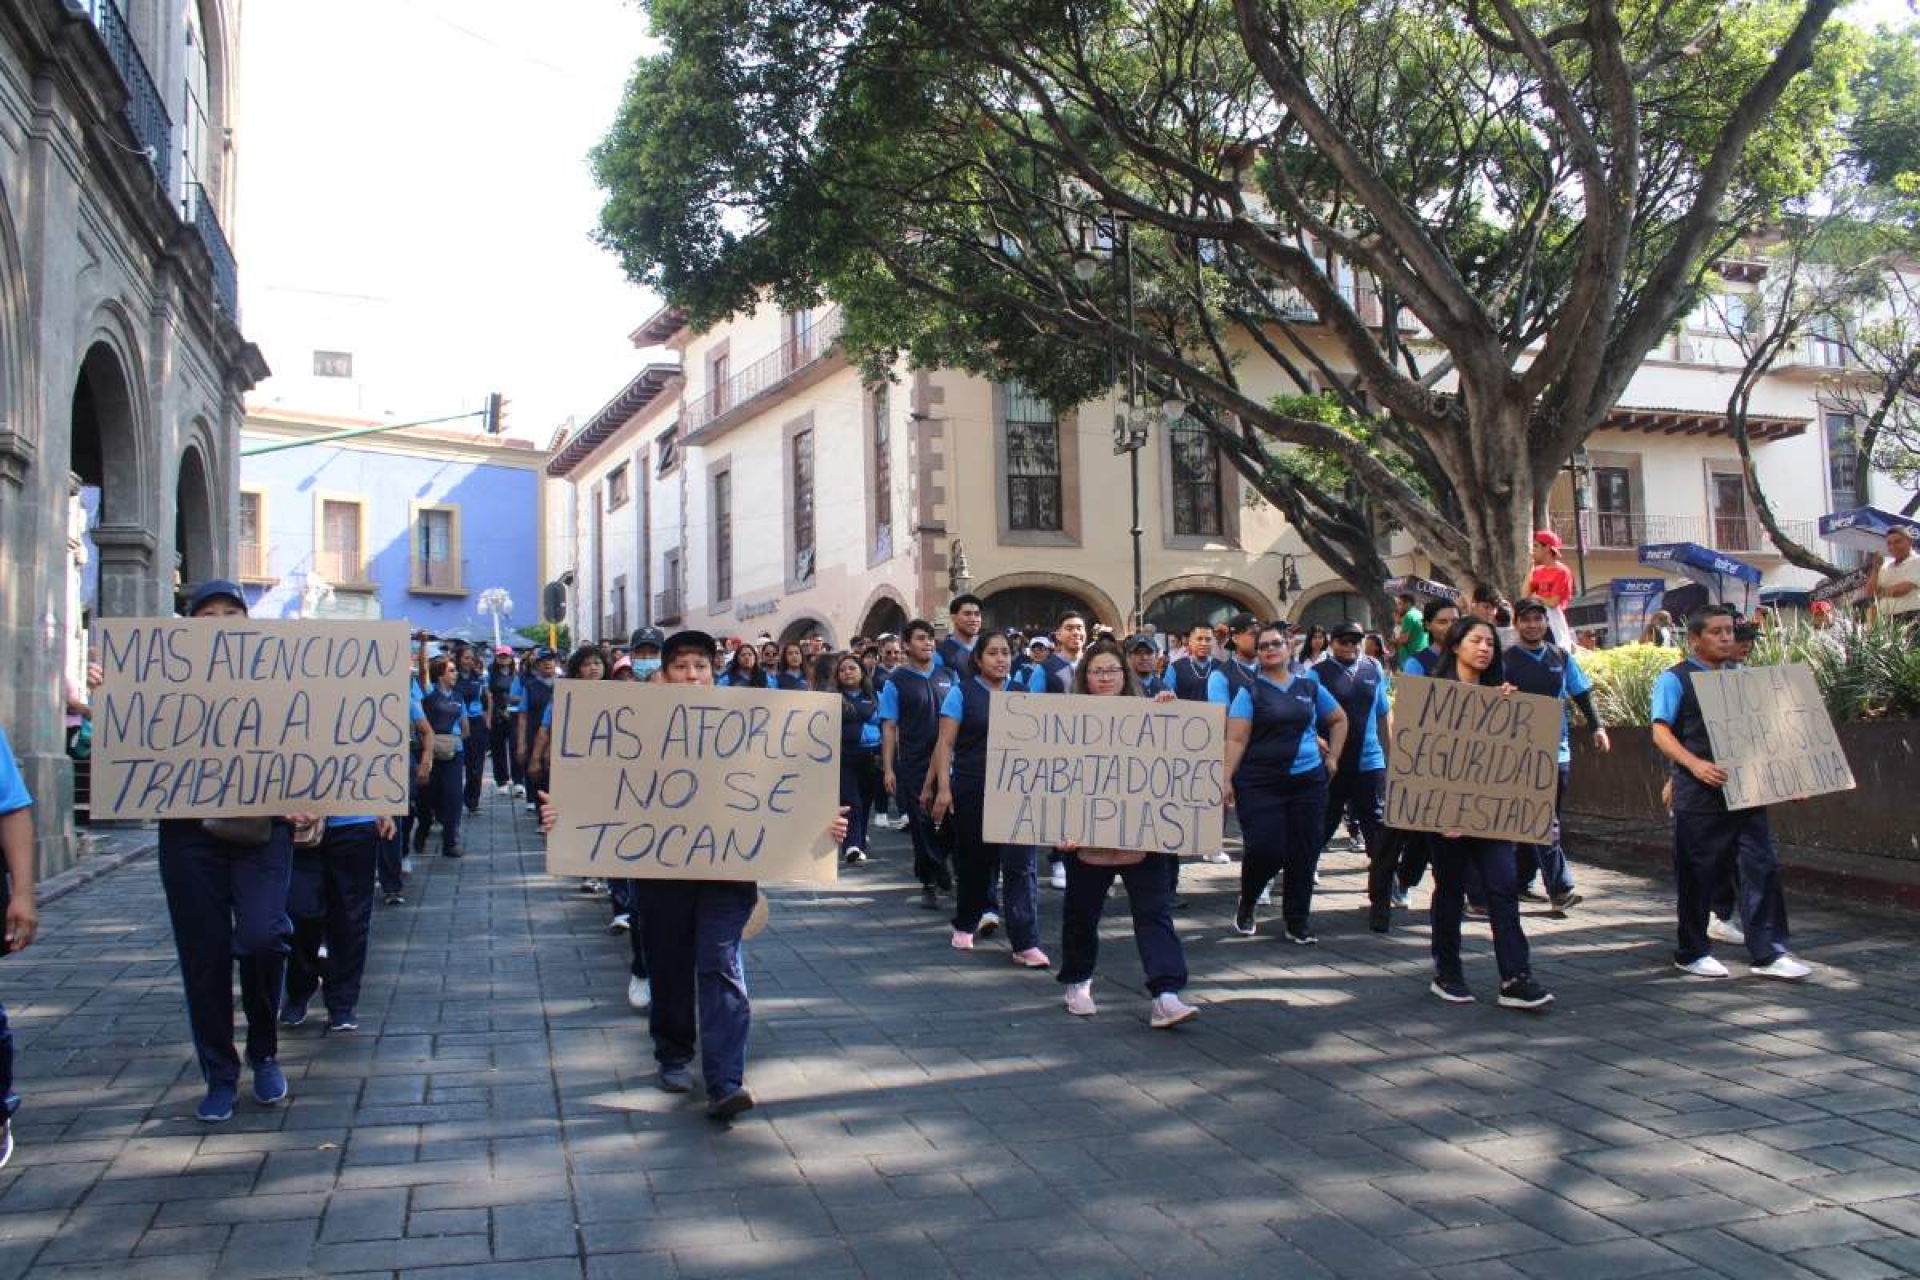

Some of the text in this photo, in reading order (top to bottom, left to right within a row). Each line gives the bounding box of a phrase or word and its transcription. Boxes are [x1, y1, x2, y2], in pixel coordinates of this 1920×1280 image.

[103, 628, 399, 683] MAS ATENCION
[104, 691, 404, 751] MEDICA A LOS
[561, 691, 833, 763] LAS AFORES
[1006, 695, 1211, 752] SINDICATO
[1419, 682, 1536, 743] MAYOR
[111, 749, 406, 813] TRABAJADORES
[994, 748, 1224, 807] TRABAJADORES
[1395, 727, 1554, 791] SEGURIDAD
[614, 768, 800, 813] NO SE
[1450, 792, 1553, 841] ESTADO
[576, 822, 766, 867] TOCAN
[1009, 796, 1211, 854] ALUPLAST
